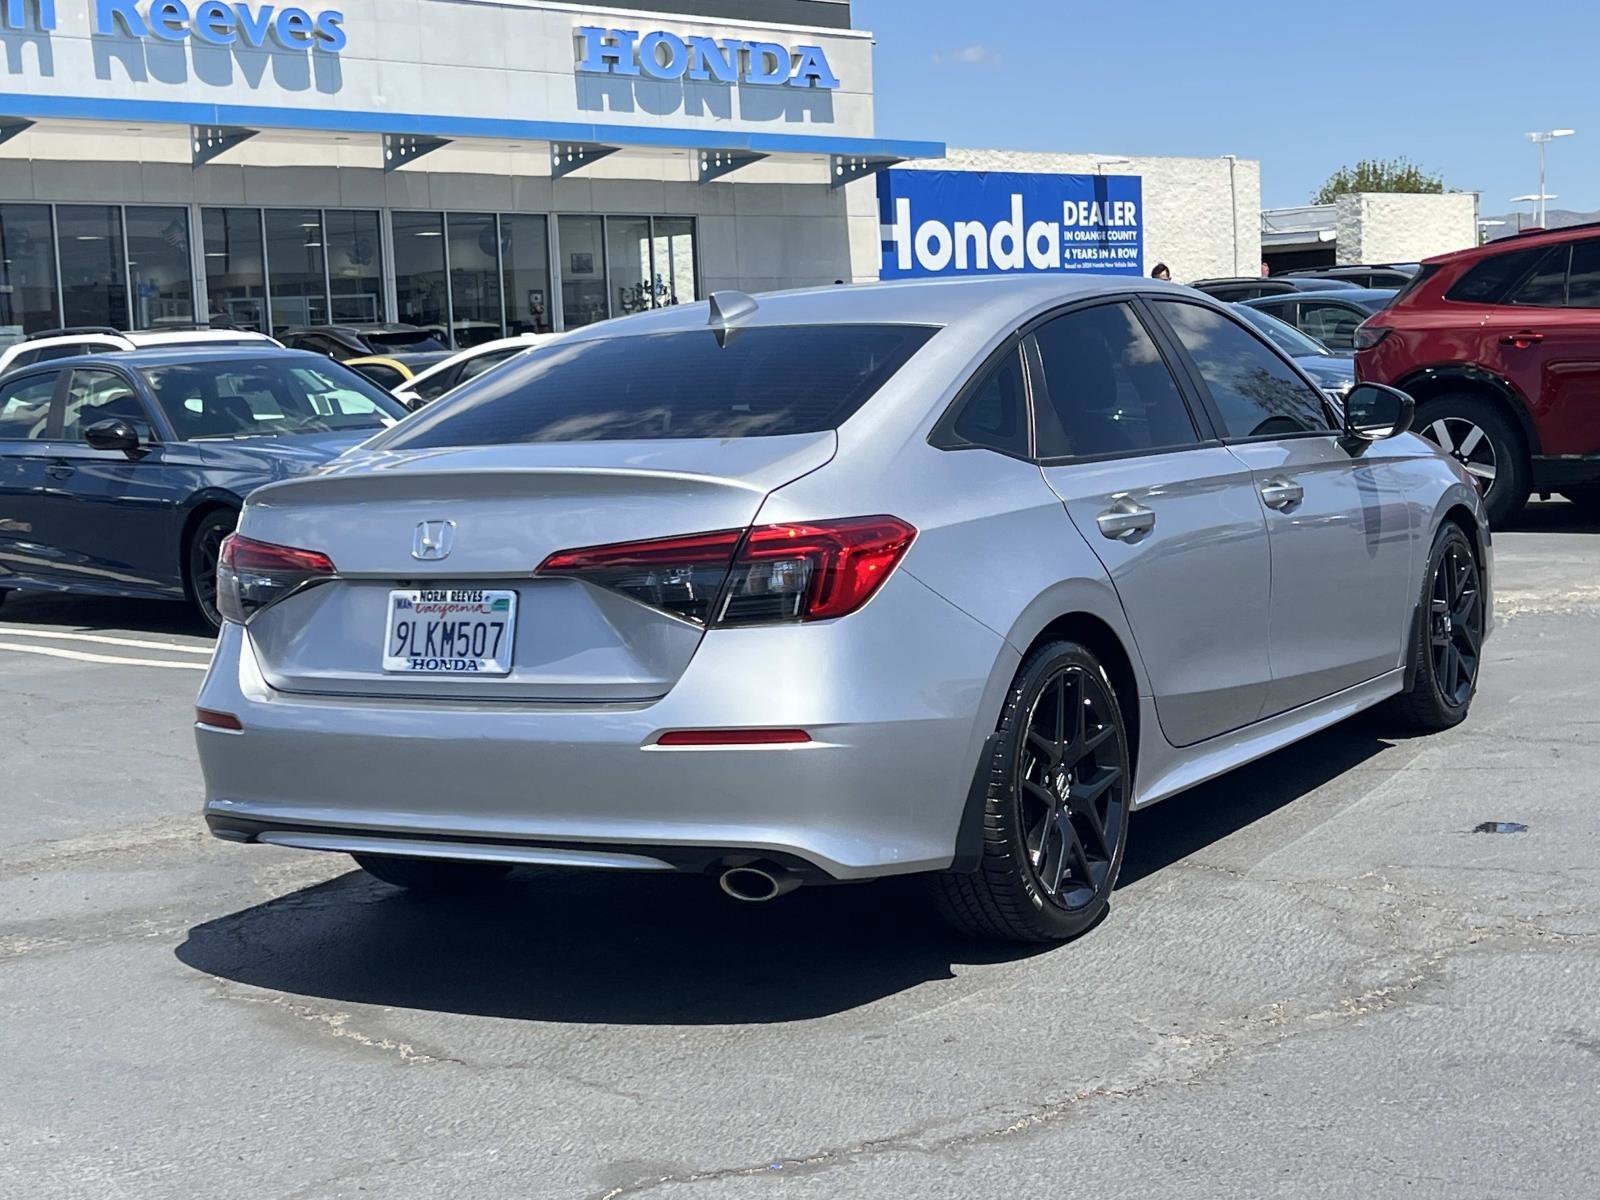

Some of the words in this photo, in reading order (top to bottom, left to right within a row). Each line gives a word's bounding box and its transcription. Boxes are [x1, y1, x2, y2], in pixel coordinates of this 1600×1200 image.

[95, 0, 347, 53] Reeves
[577, 26, 840, 89] HONDA
[1063, 200, 1137, 227] DEALER
[877, 194, 1061, 272] Honda
[1063, 231, 1074, 241] IN
[1074, 231, 1106, 241] ORANGE
[1107, 230, 1137, 241] COUNTY
[1064, 248, 1071, 260] 4
[1072, 248, 1098, 259] YEARS
[1099, 248, 1109, 259] IN
[1110, 248, 1117, 259] A
[1117, 248, 1138, 259] ROW
[420, 591, 447, 602] NORM
[451, 591, 483, 602] REEVES
[415, 603, 491, 619] California
[394, 621, 505, 658] 9LKM507
[411, 659, 479, 671] HONDA
